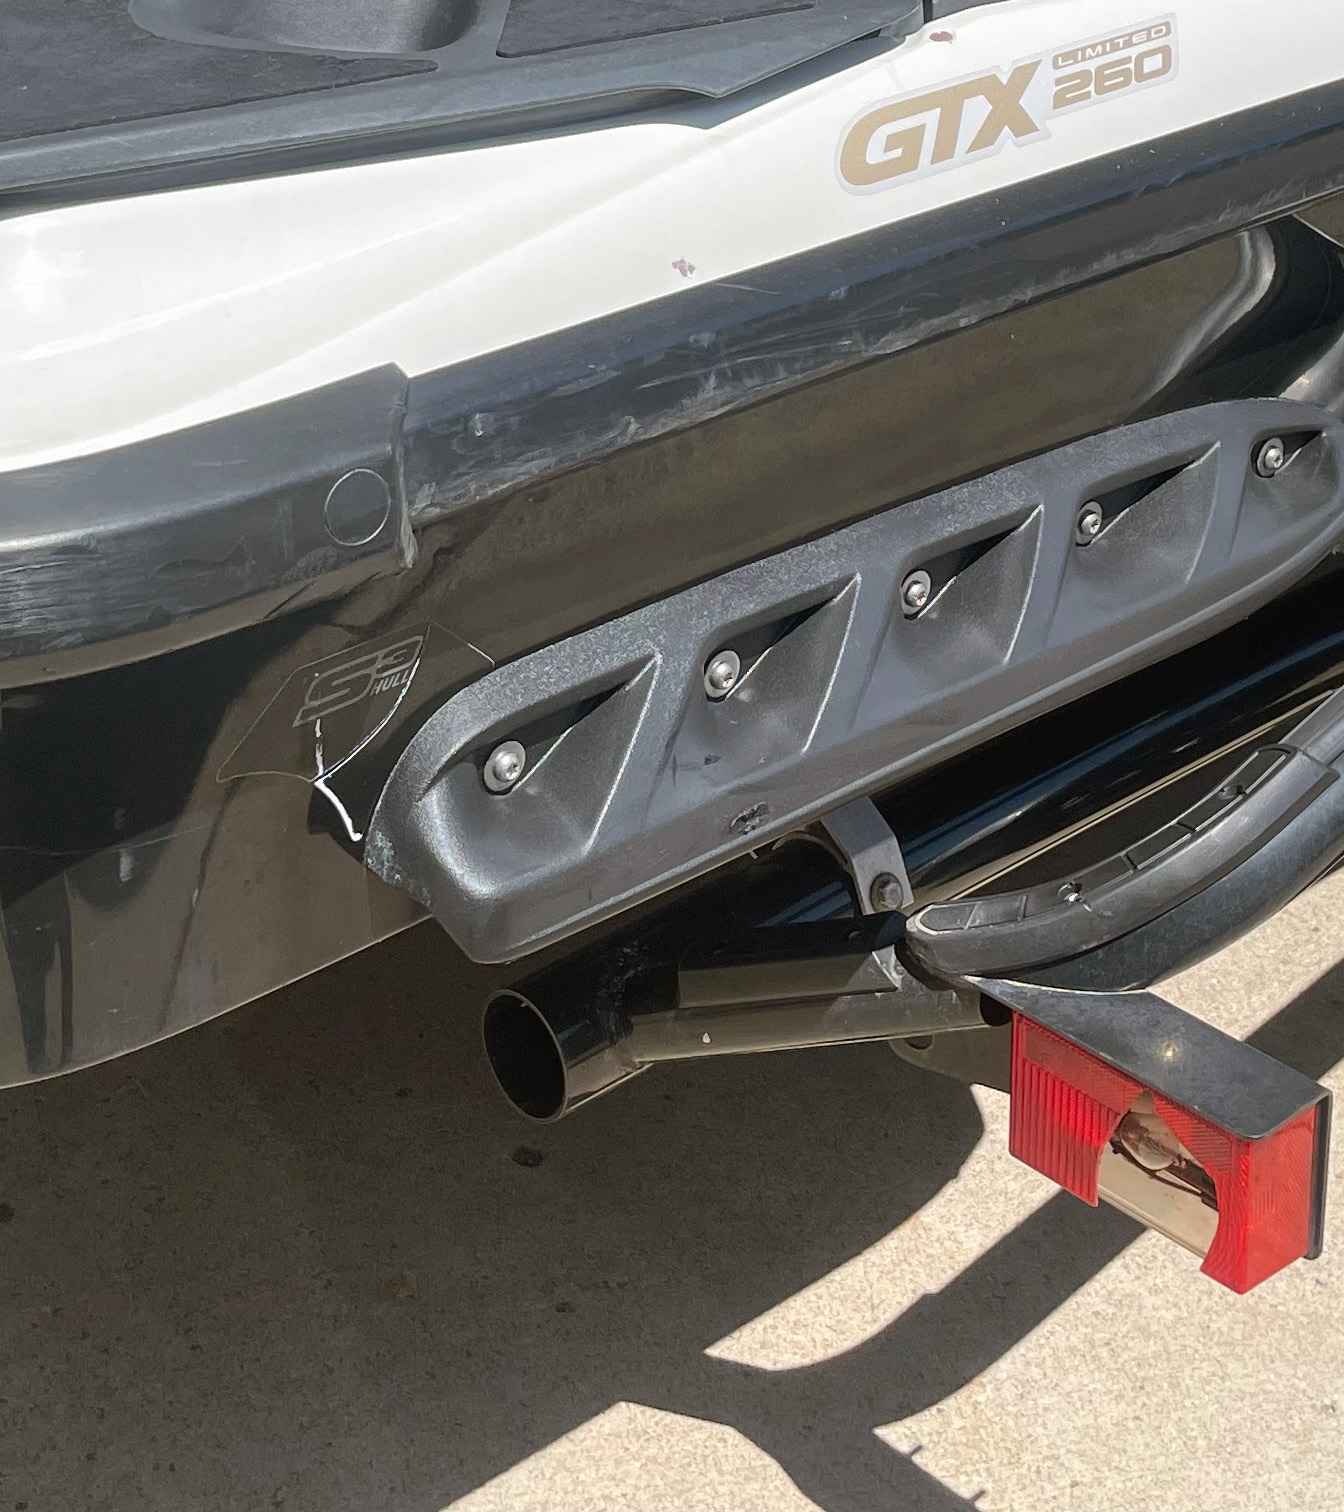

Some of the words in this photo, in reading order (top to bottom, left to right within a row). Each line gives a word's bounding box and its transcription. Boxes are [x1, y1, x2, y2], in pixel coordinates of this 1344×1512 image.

[1057, 24, 1168, 68] LIMITED
[1052, 44, 1173, 111] 260
[839, 59, 1043, 186] GTX
[369, 670, 410, 697] HULL
